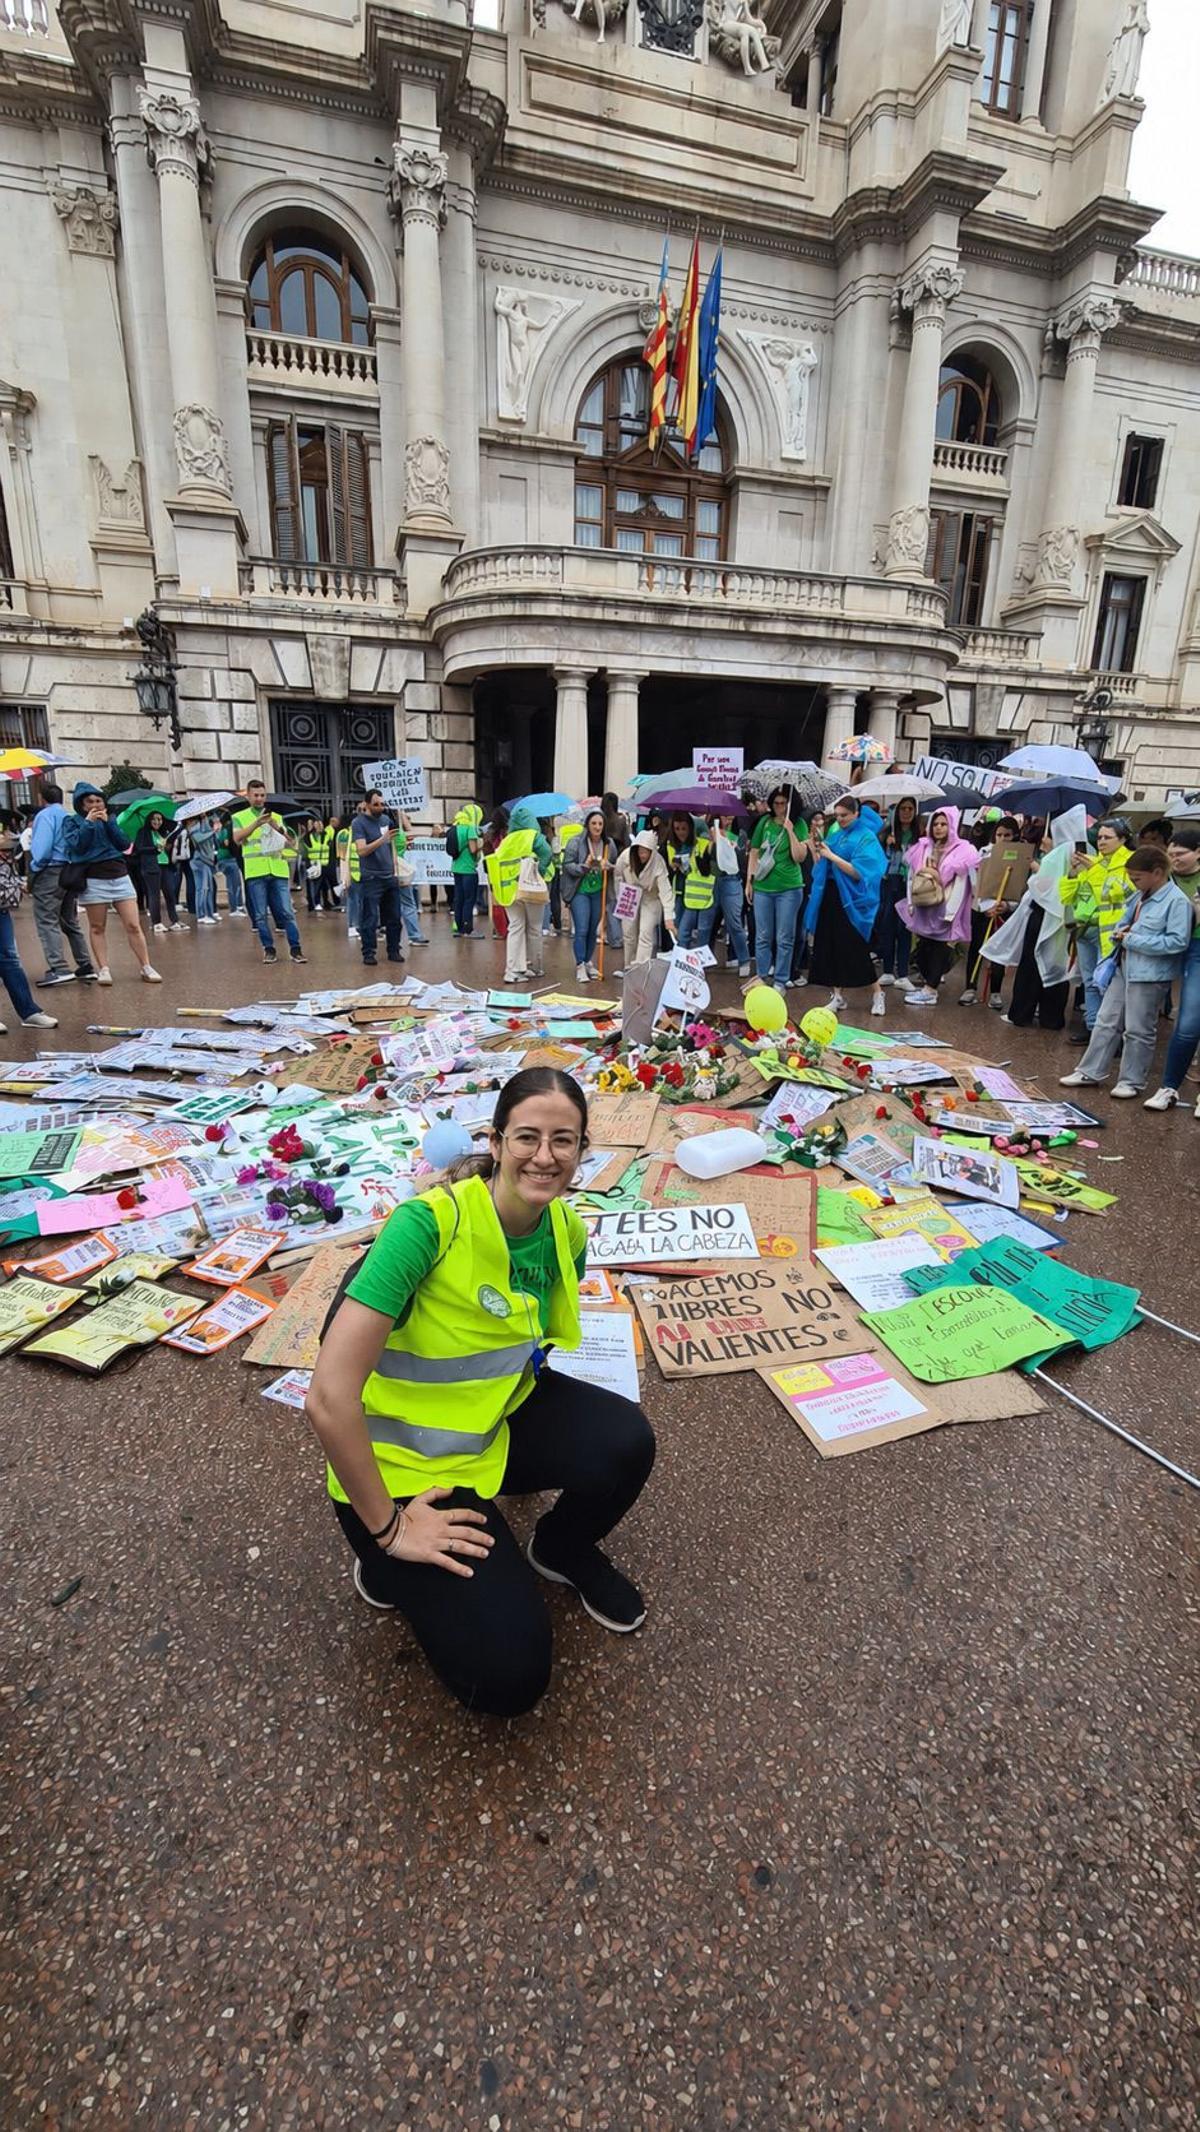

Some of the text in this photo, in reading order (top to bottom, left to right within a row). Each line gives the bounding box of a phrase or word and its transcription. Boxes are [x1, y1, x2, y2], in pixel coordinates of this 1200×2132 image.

[916, 758, 949, 787] NO
[690, 1208, 735, 1231] NO
[651, 1236, 674, 1253] LA
[677, 1232, 753, 1251] CABEZA
[781, 1287, 832, 1315] NO
[658, 1324, 829, 1367] VALIENTES
